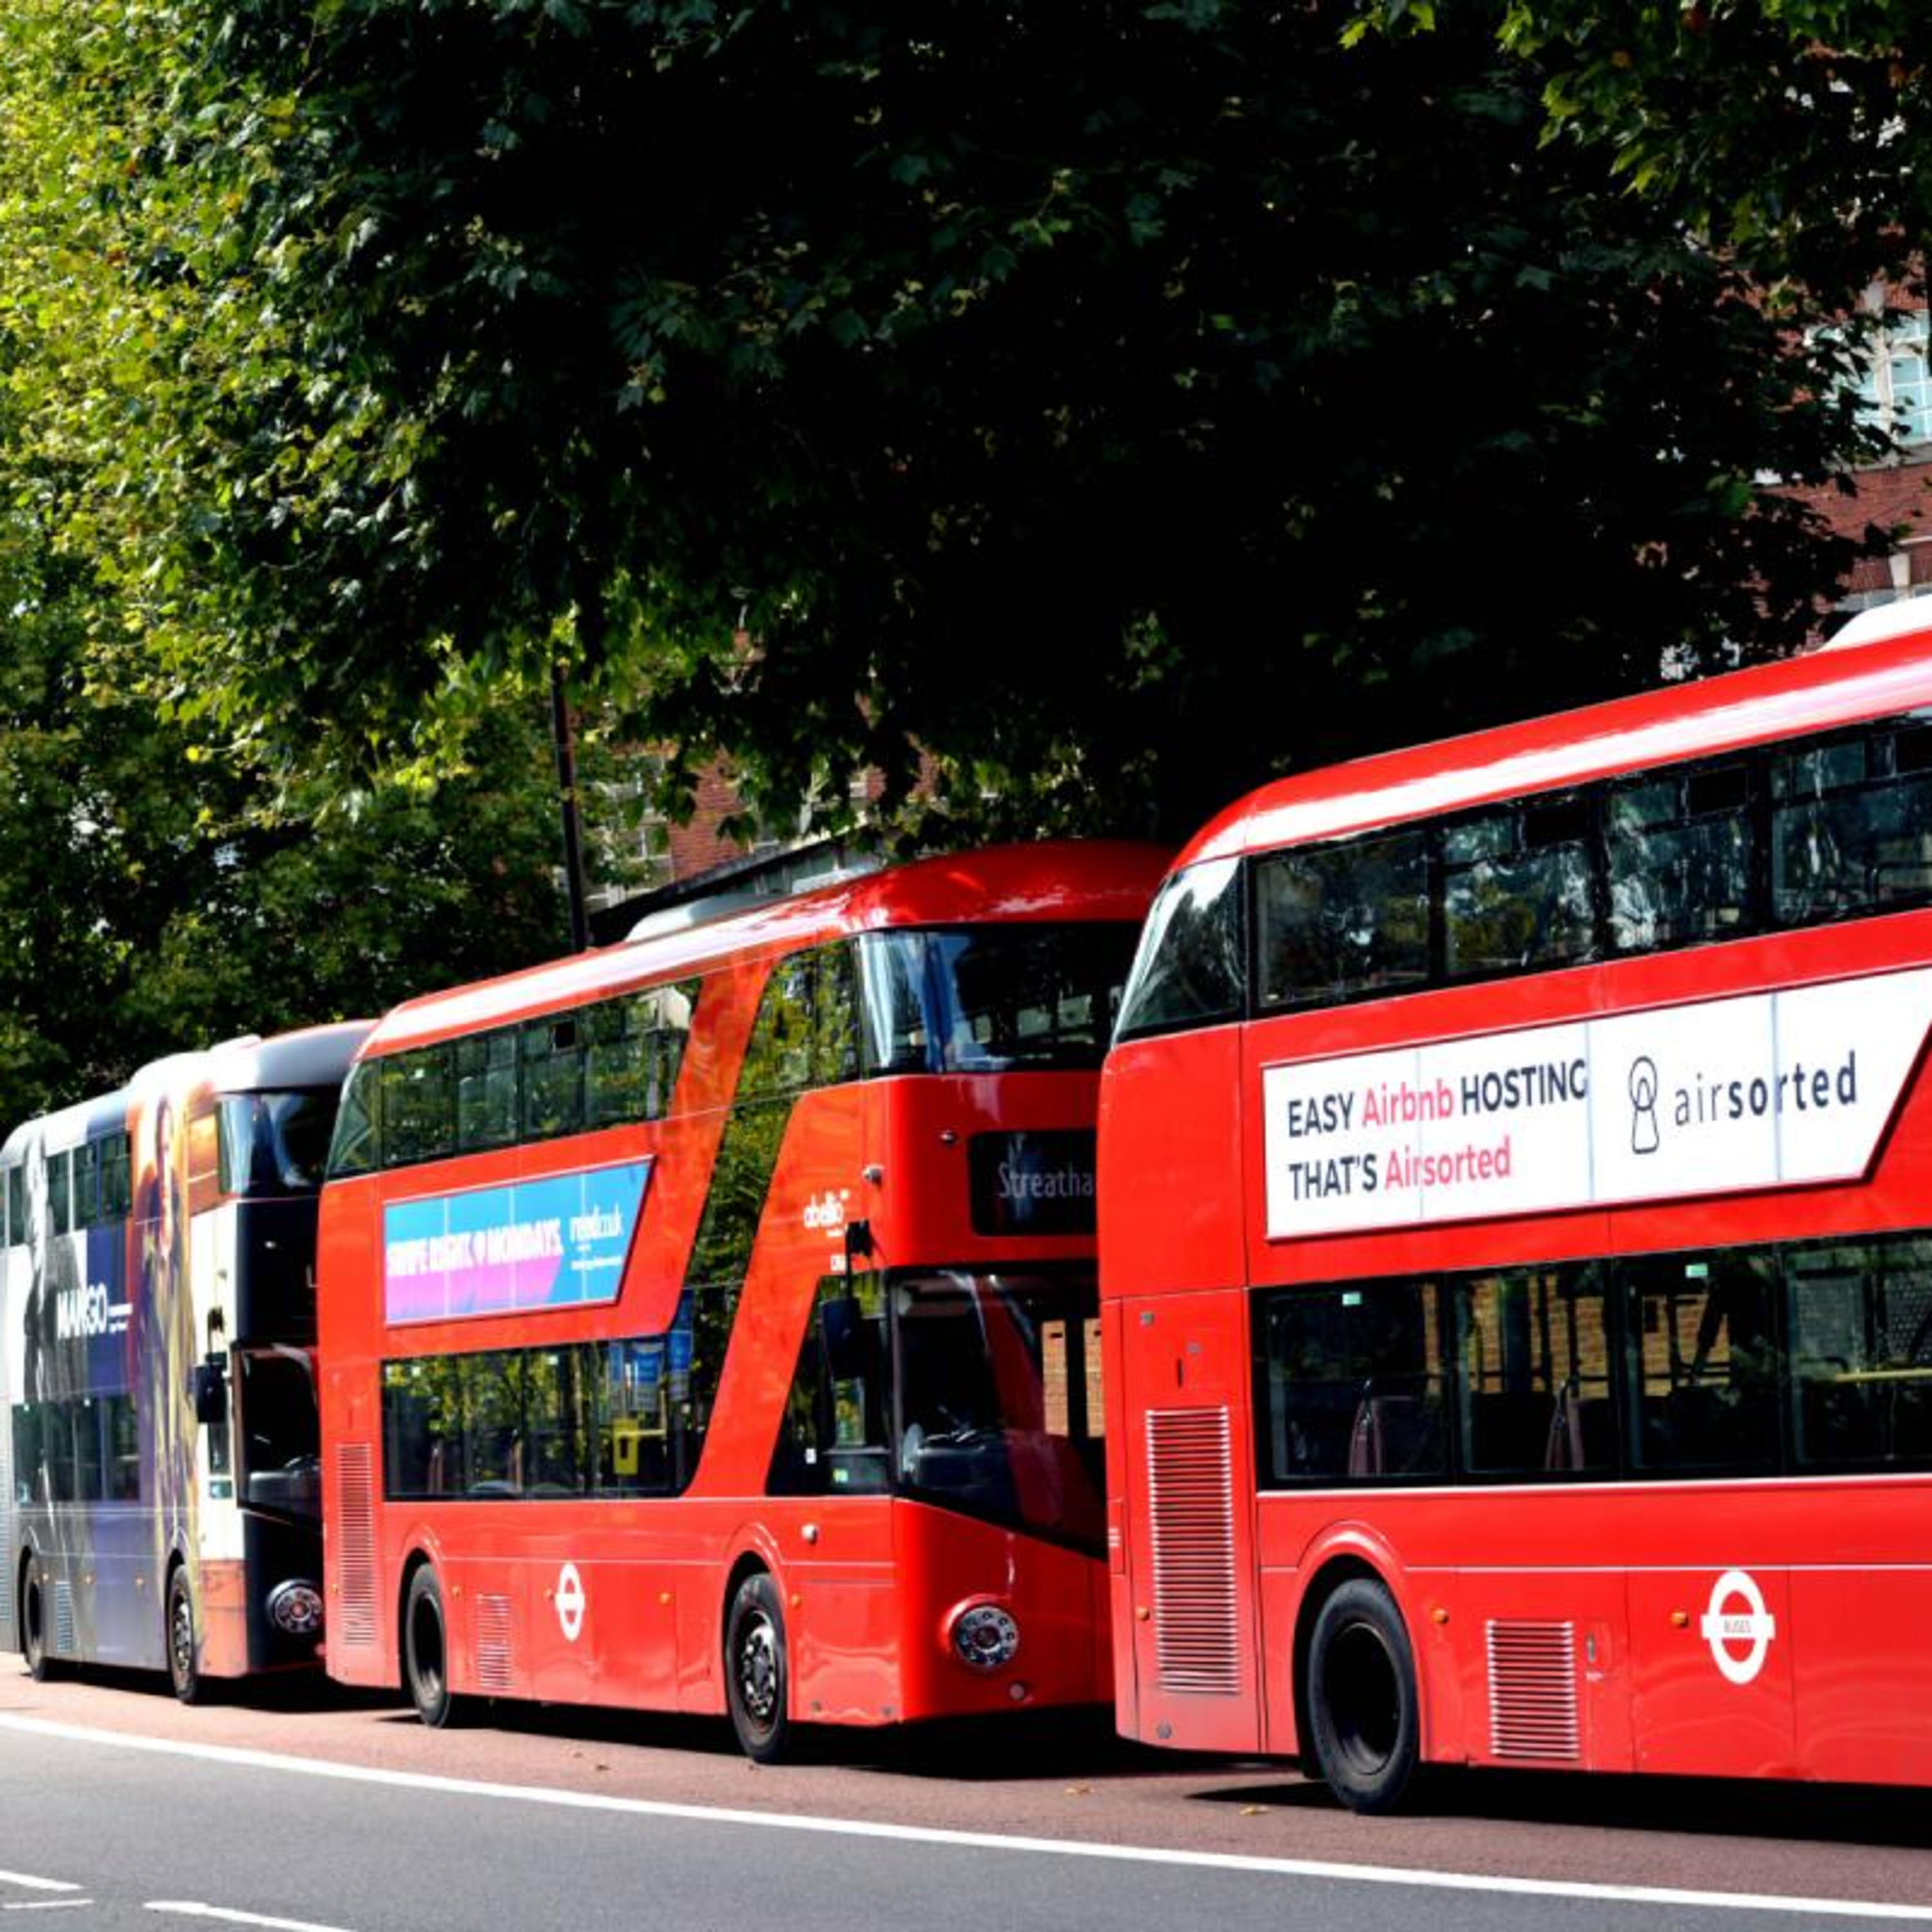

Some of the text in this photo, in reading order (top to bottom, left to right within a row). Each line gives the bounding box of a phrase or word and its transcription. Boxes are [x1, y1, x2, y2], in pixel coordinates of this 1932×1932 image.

[1288, 1058, 1588, 1138] EASY Airbnb HOSTING
[1675, 1049, 1857, 1127] airsorted
[1289, 1135, 1512, 1202] THAT'S Airsorted
